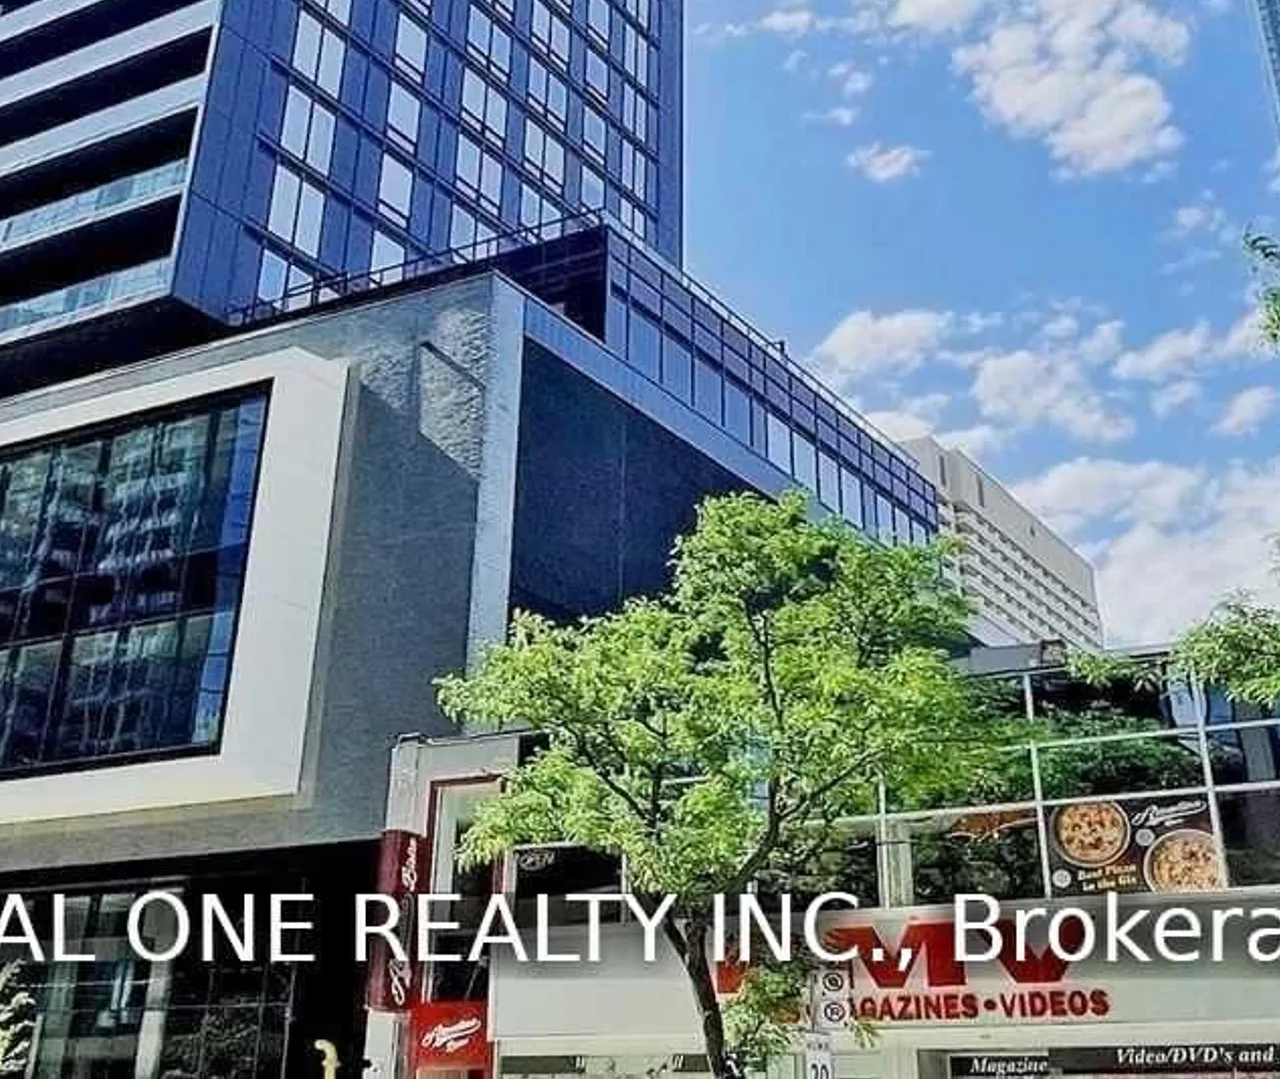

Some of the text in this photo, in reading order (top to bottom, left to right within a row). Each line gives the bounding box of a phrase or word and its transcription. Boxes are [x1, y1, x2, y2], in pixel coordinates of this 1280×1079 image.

[808, 992, 978, 1021] GAZINES
[1000, 989, 1110, 1018] VIDEOS
[1117, 1047, 1234, 1065] Video/DVD's
[1238, 1046, 1275, 1063] and
[969, 1057, 1049, 1075] Magazine
